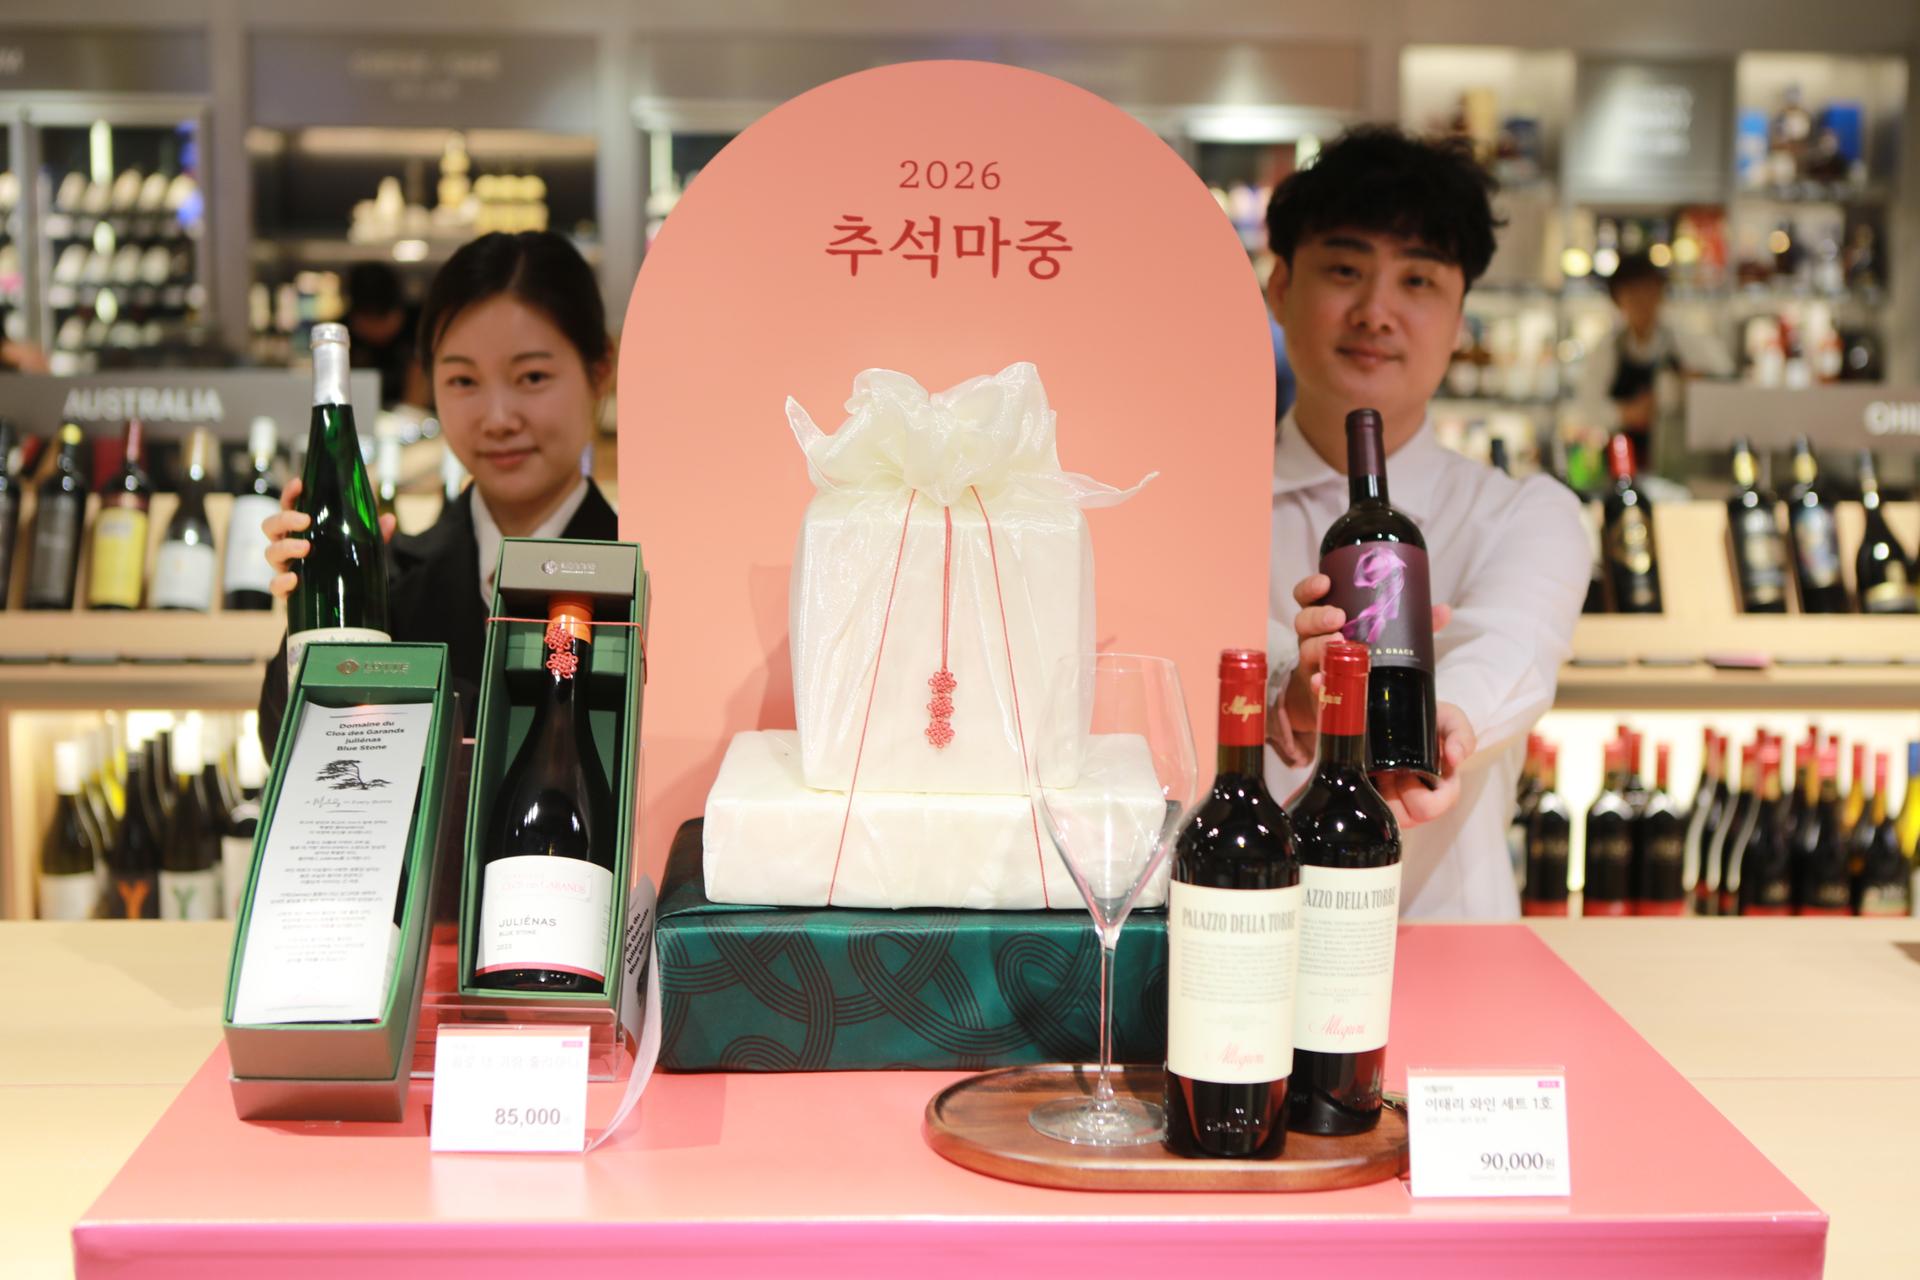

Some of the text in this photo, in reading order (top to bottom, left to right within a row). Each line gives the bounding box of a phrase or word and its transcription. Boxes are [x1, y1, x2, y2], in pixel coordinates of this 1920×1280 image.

[899, 159, 1001, 190] 2026
[824, 214, 1074, 281] 추석마중
[64, 387, 223, 421] AUSTRALIA
[1863, 401, 1920, 436] CHI
[1385, 647, 1415, 656] GRACE
[339, 721, 380, 729] Domaine
[1303, 888, 1332, 909] AZZO
[1336, 890, 1369, 910] DELLA
[498, 914, 557, 928] JULIÉNAS
[1182, 908, 1227, 932] PALAZZO
[1230, 912, 1265, 934] DELLA
[1425, 1097, 1553, 1112] 이태리 와인 세트 1호
